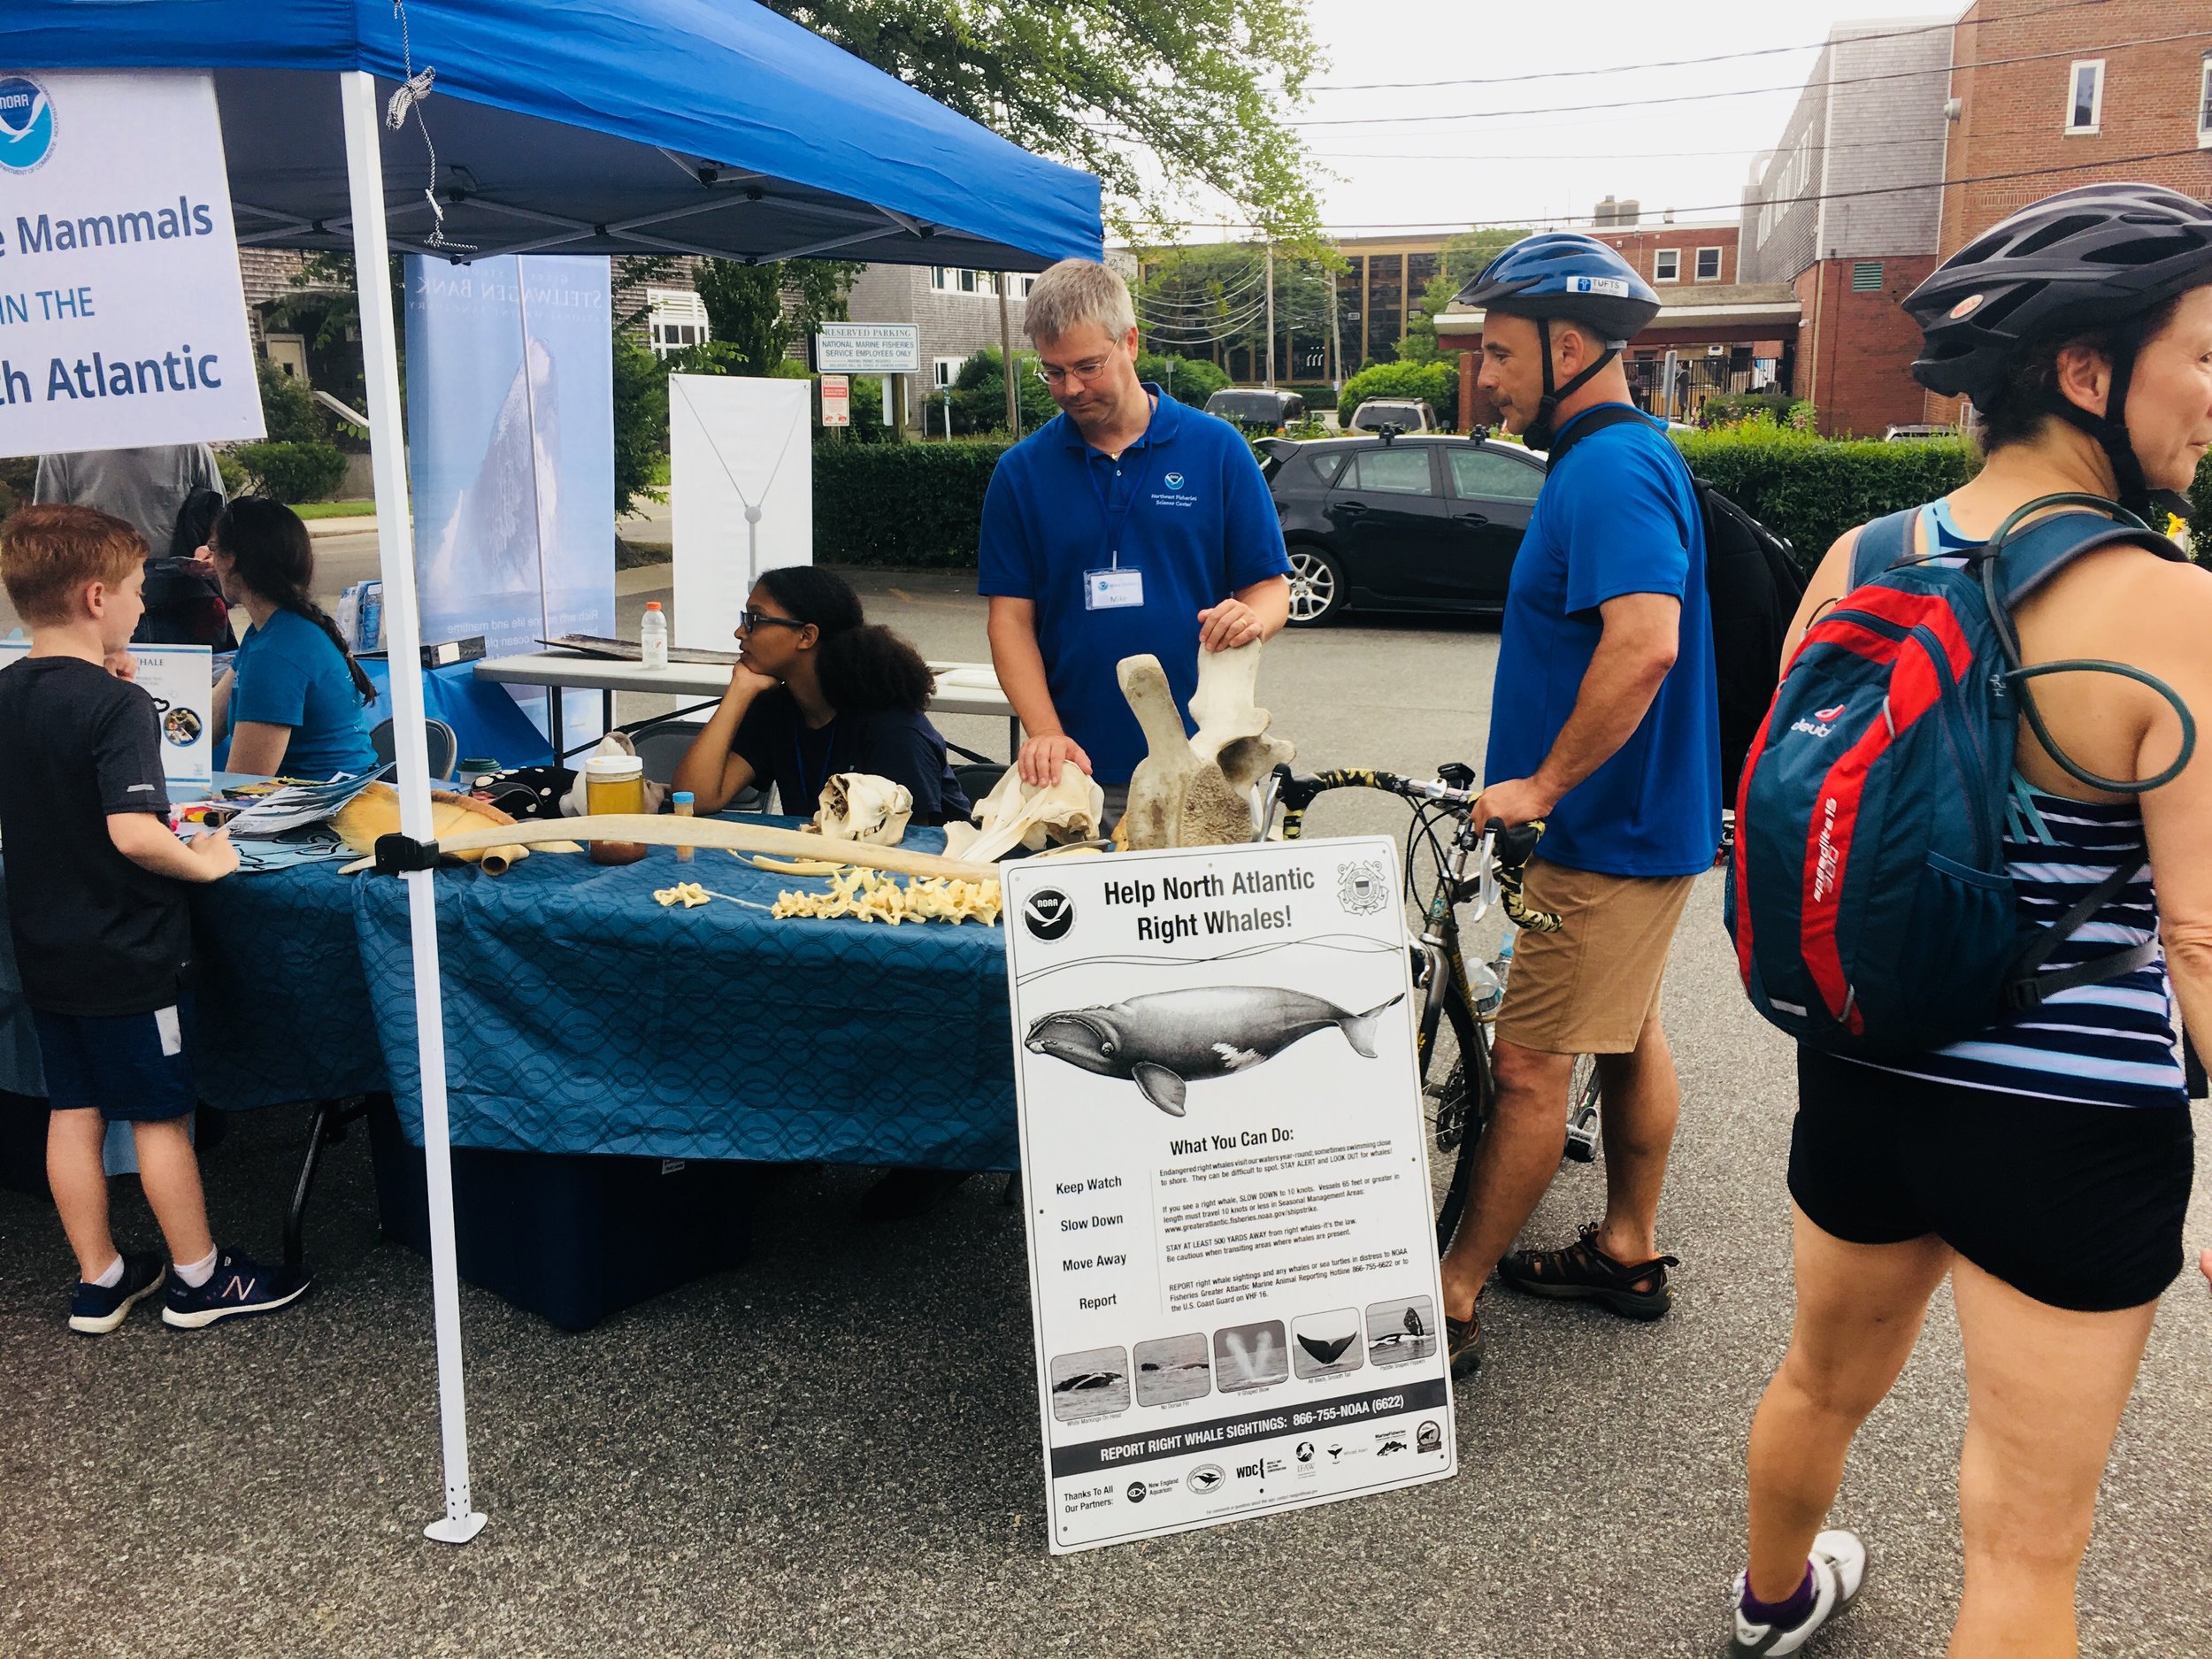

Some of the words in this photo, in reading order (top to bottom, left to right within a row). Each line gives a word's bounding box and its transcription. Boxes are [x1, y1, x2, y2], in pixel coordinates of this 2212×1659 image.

[16, 196, 213, 254] Mammals
[1592, 279, 1620, 289] TUFTS
[0, 293, 29, 325] IN
[35, 286, 95, 320] THE
[0, 356, 32, 406] h
[47, 344, 221, 401] Atlantic
[136, 657, 165, 666] HALE
[1104, 879, 1155, 908] Help
[1163, 873, 1224, 900] North
[1232, 867, 1314, 895] Atlantic
[1037, 898, 1058, 908] NOAA
[1137, 913, 1198, 943] Right
[1203, 904, 1291, 934] Whales!
[1170, 1137, 1208, 1156] What
[1210, 1134, 1236, 1150] You
[1240, 1131, 1267, 1146] Can
[1271, 1127, 1294, 1142] Do:
[1056, 1182, 1083, 1194] Keep
[1087, 1175, 1122, 1190] Watch
[1201, 1199, 1216, 1209] right
[1217, 1196, 1238, 1205] whale,
[1239, 1193, 1256, 1202] SLOW
[1258, 1190, 1278, 1199] DOWN
[1317, 1181, 1340, 1190] Vessels
[1371, 1174, 1392, 1184] greater
[1163, 1214, 1183, 1223] length
[1184, 1211, 1201, 1220] must
[1202, 1209, 1220, 1217] travel
[1278, 1196, 1305, 1207] Seasonal
[1306, 1191, 1345, 1202] Management
[1060, 1219, 1087, 1232] Slow
[1091, 1214, 1123, 1227] Down
[1165, 1243, 1181, 1252] STAY
[1193, 1238, 1212, 1248] LEAST
[1226, 1233, 1248, 1243] YARDS
[1248, 1231, 1266, 1240] AWAY
[1284, 1226, 1299, 1235] right
[1299, 1221, 1333, 1232] whales-it's
[1176, 1251, 1203, 1261] cautious
[1223, 1244, 1253, 1254] transiting
[1254, 1240, 1271, 1249] areas
[1293, 1234, 1315, 1243] whales
[1326, 1228, 1350, 1239] present.
[1062, 1258, 1093, 1271] Move
[1096, 1254, 1126, 1266] Away
[1169, 1280, 1194, 1291] REPORT
[1195, 1279, 1210, 1288] right
[1211, 1276, 1231, 1285] whale
[1232, 1271, 1261, 1282] sightings
[1288, 1263, 1310, 1272] whales
[1359, 1253, 1382, 1262] distress
[222, 1275, 256, 1301] N
[1170, 1292, 1198, 1302] Fisheries
[1200, 1287, 1224, 1297] Greater
[1225, 1284, 1249, 1293] Atlantic
[1251, 1279, 1273, 1288] Marine
[1275, 1275, 1296, 1285] Animal
[1298, 1271, 1327, 1281] Reporting
[1352, 1260, 1393, 1272] 866-755-6622
[1079, 1294, 1117, 1310] Report
[1196, 1299, 1214, 1308] Coast
[1216, 1295, 1234, 1305] Guard
[1244, 1291, 1257, 1300] VHF
[1100, 1441, 1145, 1461] REPORT
[1148, 1434, 1182, 1453] RIGHT
[1184, 1427, 1224, 1446] WHALE
[1225, 1416, 1287, 1438] SIGHTINGS:
[1292, 1401, 1370, 1425] 866-755-NOAA
[1371, 1394, 1403, 1413] (6622)
[1159, 1478, 1179, 1486] England
[1236, 1463, 1259, 1479] WDC
[1064, 1490, 1091, 1501] Thanks
[1103, 1485, 1113, 1494] All
[1149, 1486, 1172, 1495] Aquarium
[1064, 1504, 1078, 1513] Our
[1079, 1499, 1113, 1510] Partners:
